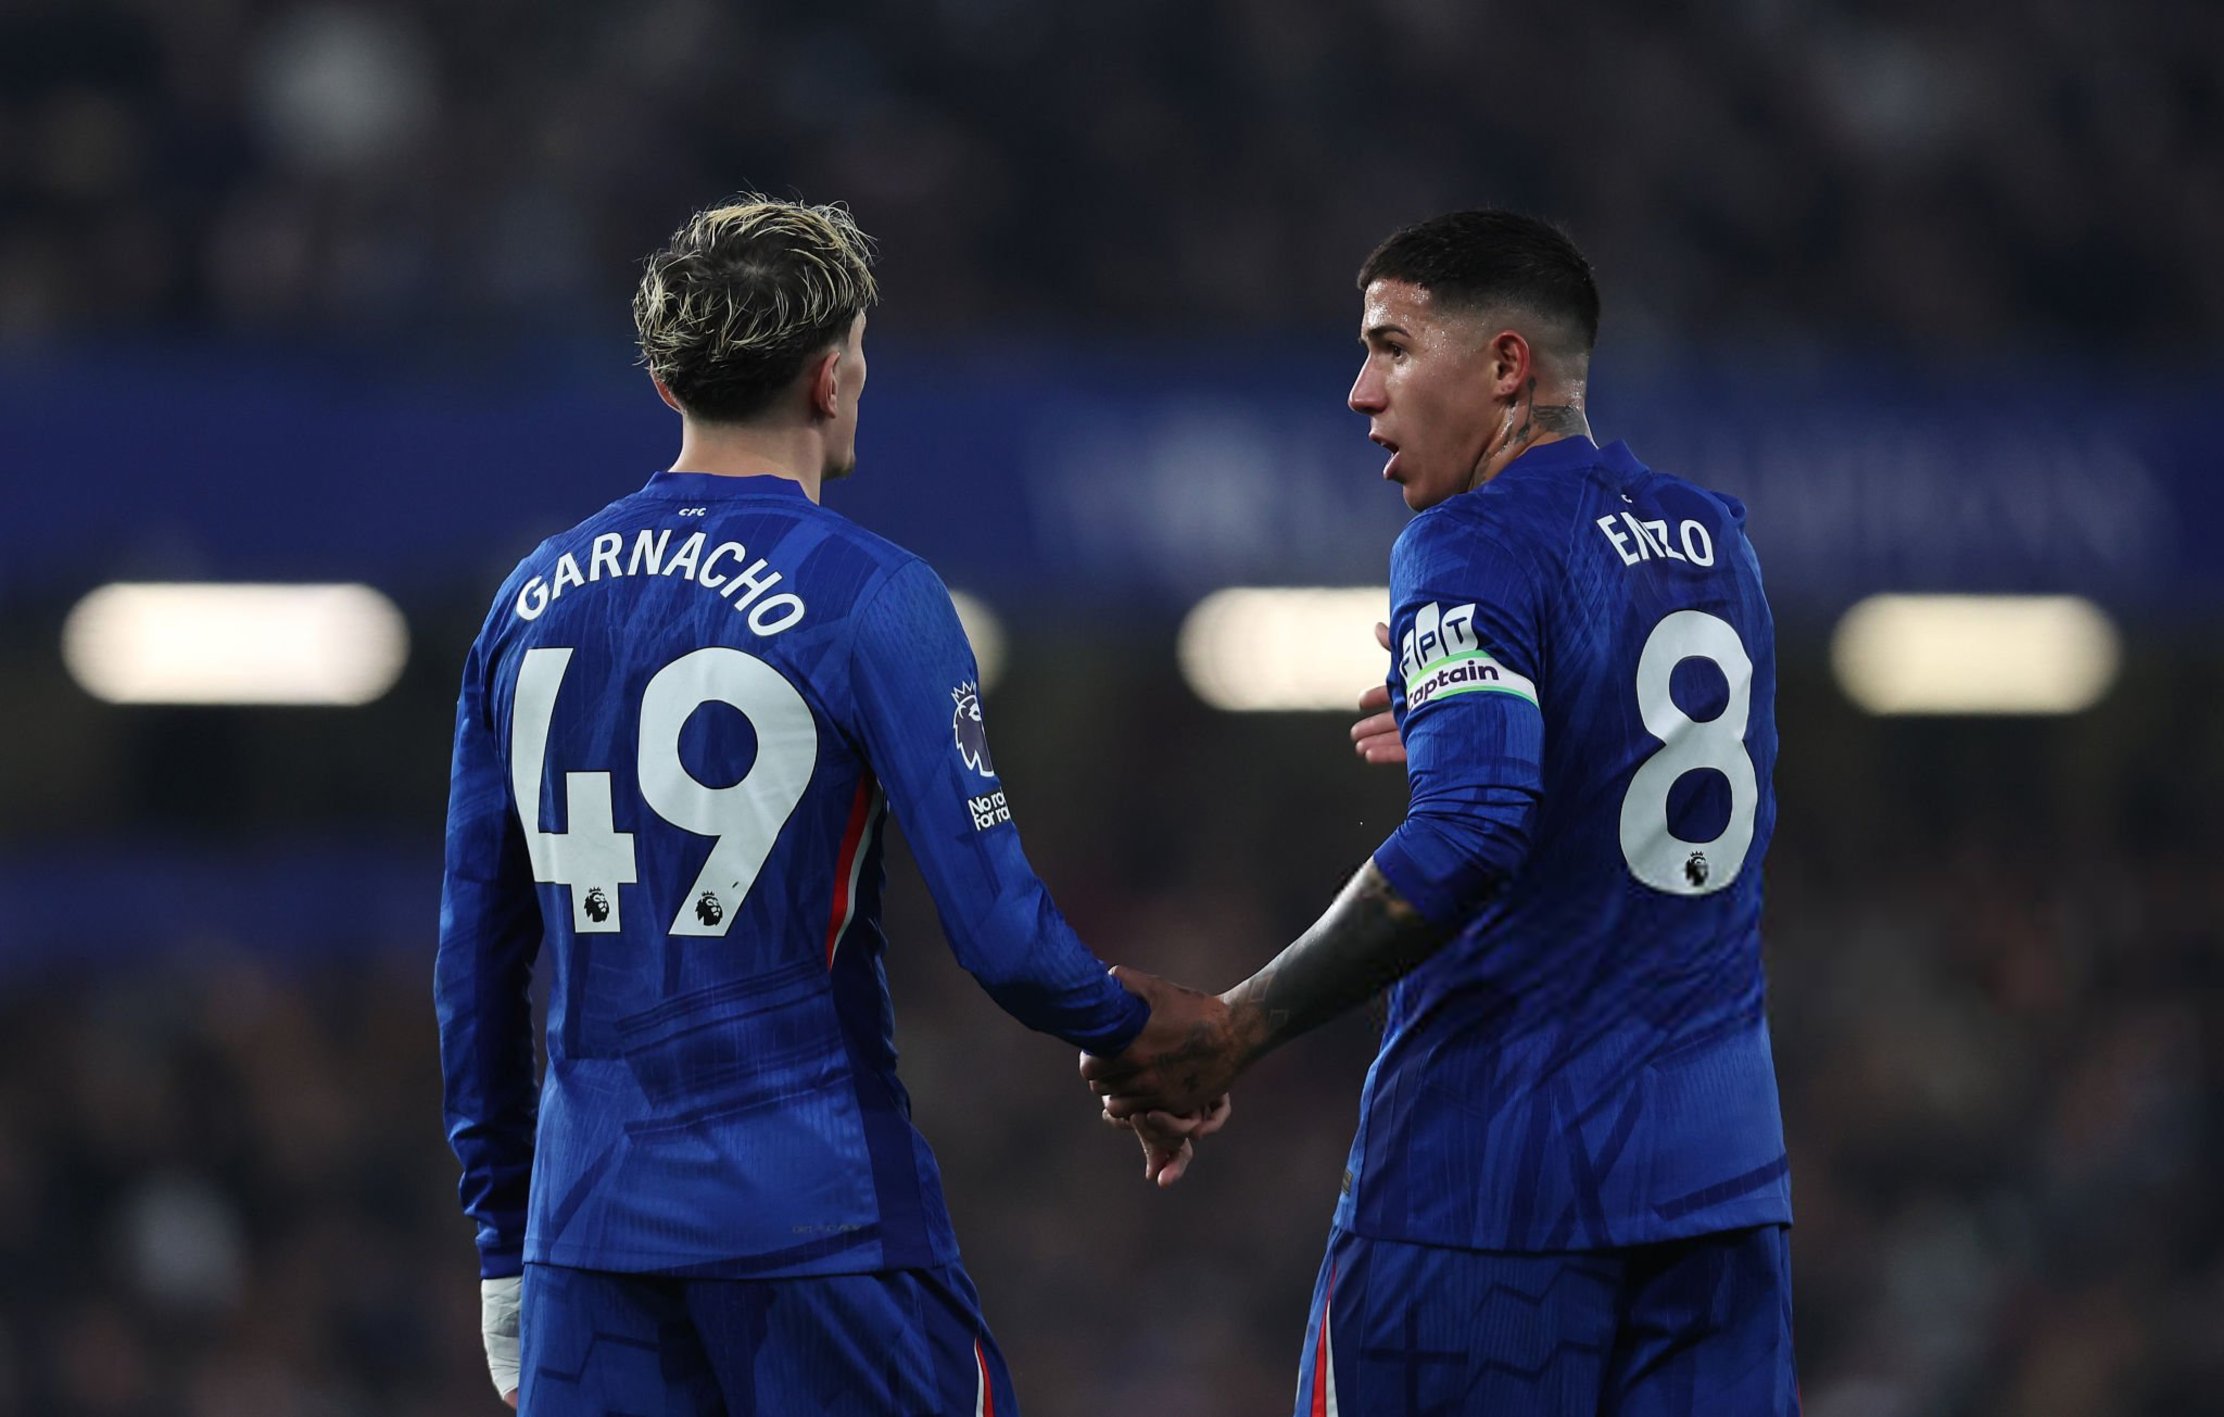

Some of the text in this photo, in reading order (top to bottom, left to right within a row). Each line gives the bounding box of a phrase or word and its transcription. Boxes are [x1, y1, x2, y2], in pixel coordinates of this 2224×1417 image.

[678, 507, 707, 517] CFC
[1596, 511, 1715, 567] ENZO
[515, 529, 806, 637] GARNACHO
[511, 647, 818, 937] 49
[1619, 609, 1758, 896] 8
[968, 796, 991, 816] No
